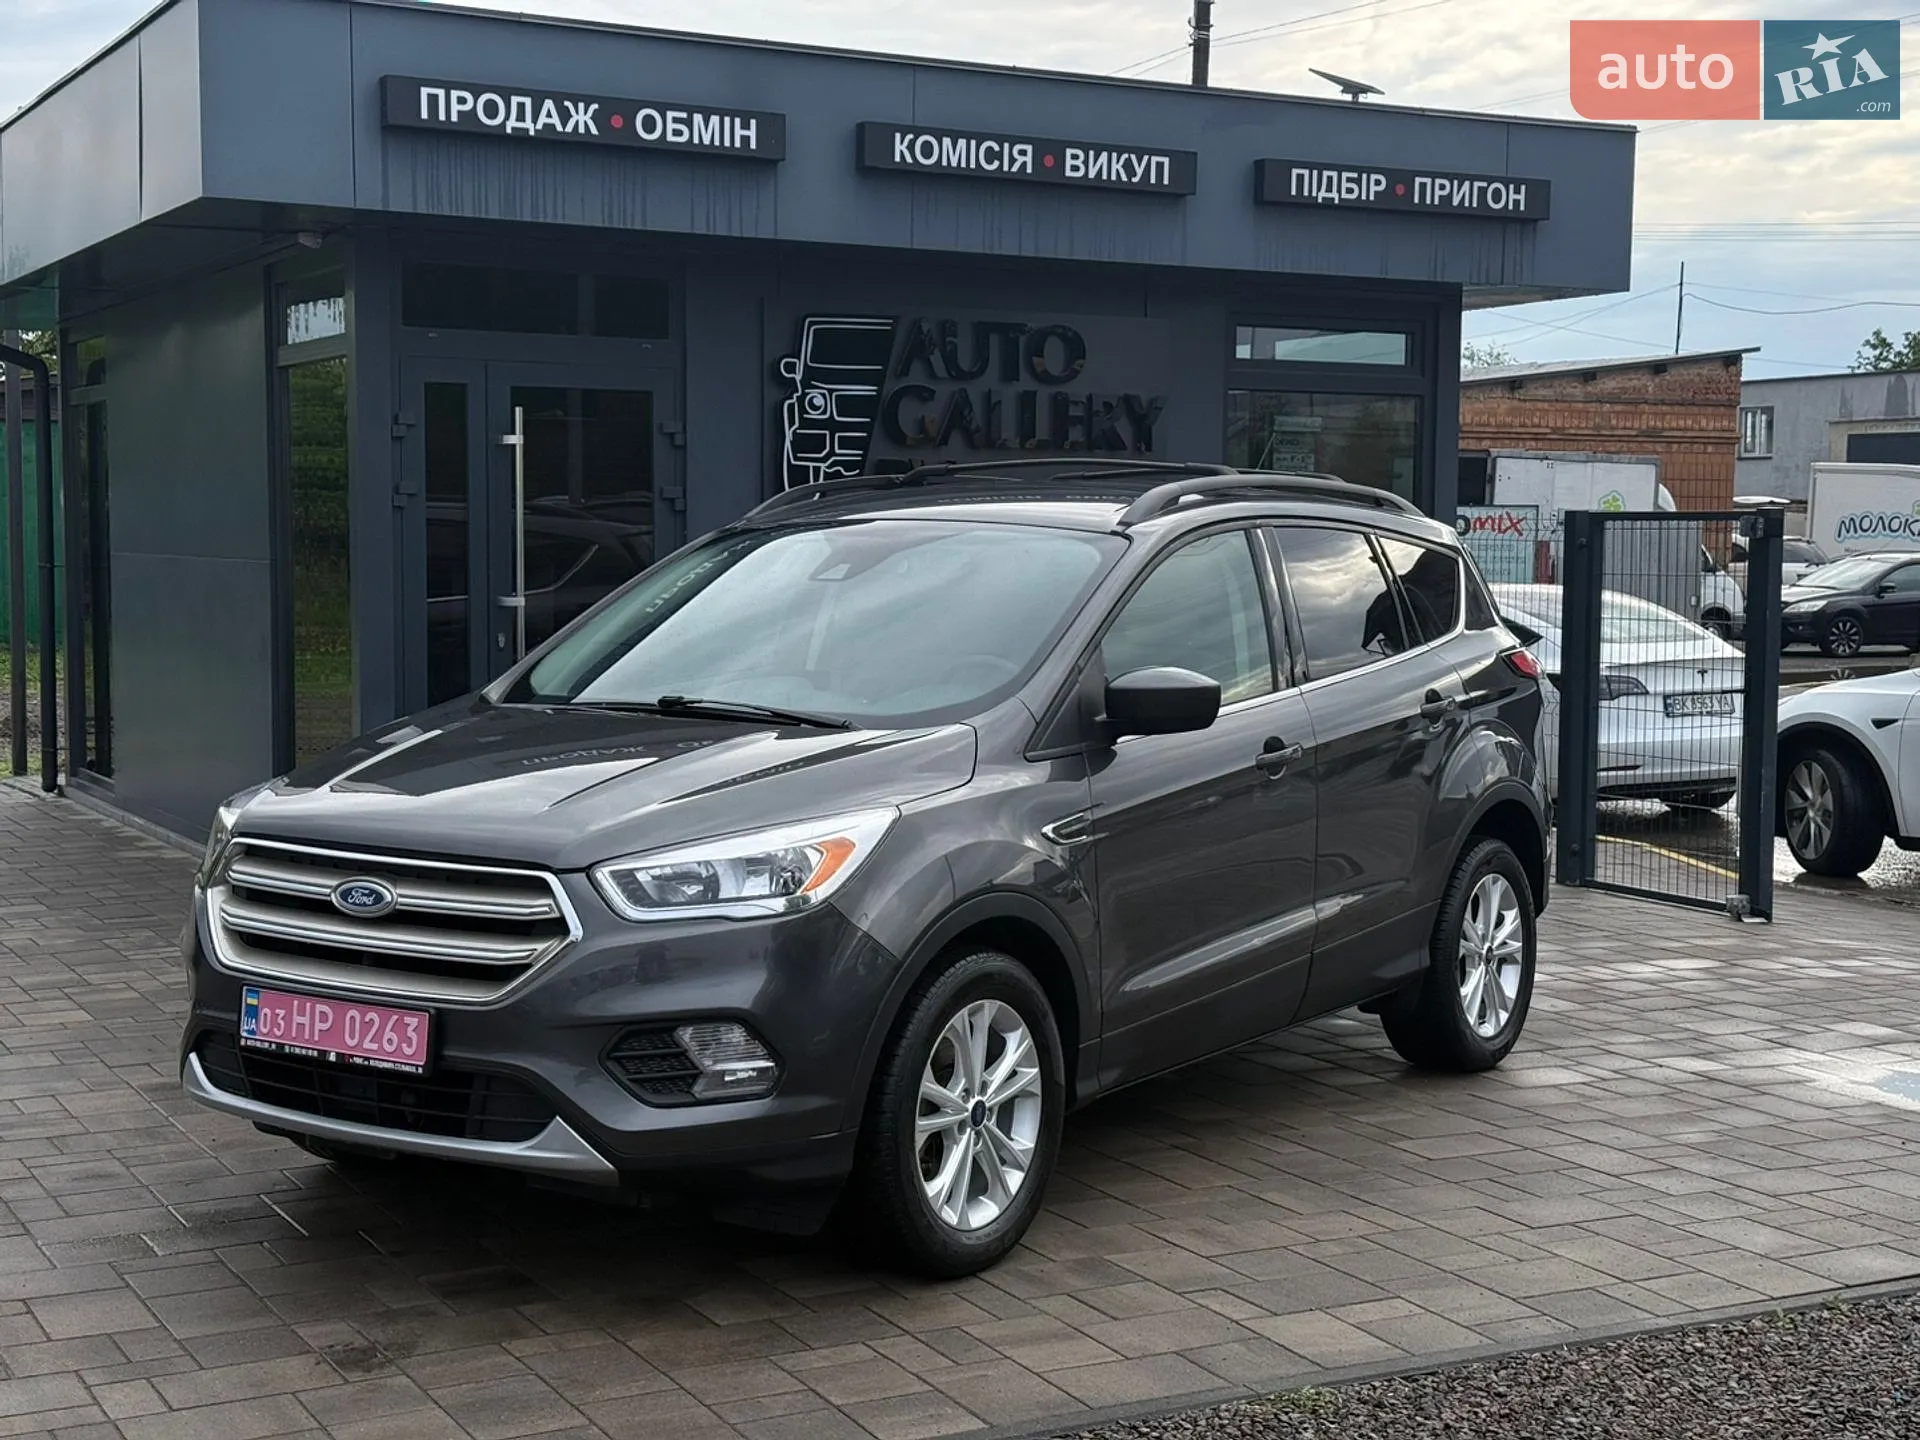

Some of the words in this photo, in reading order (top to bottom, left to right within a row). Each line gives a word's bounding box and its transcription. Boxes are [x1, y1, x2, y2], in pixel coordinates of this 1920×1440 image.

[420, 86, 599, 135] ПРОДАЖ
[635, 107, 758, 150] ОБМІН
[894, 132, 1033, 174] КОМІСІЯ
[1064, 148, 1170, 185] ВИКУП
[1290, 167, 1387, 204] ПІДБІР
[1413, 177, 1527, 211] ПРИГОН
[898, 316, 1087, 385] AUTO
[883, 384, 1166, 453] GALLERY
[1837, 514, 1920, 538] МОЛОК
[347, 887, 376, 905] Ford
[243, 1016, 257, 1031] UA
[344, 1009, 419, 1056] 0263
